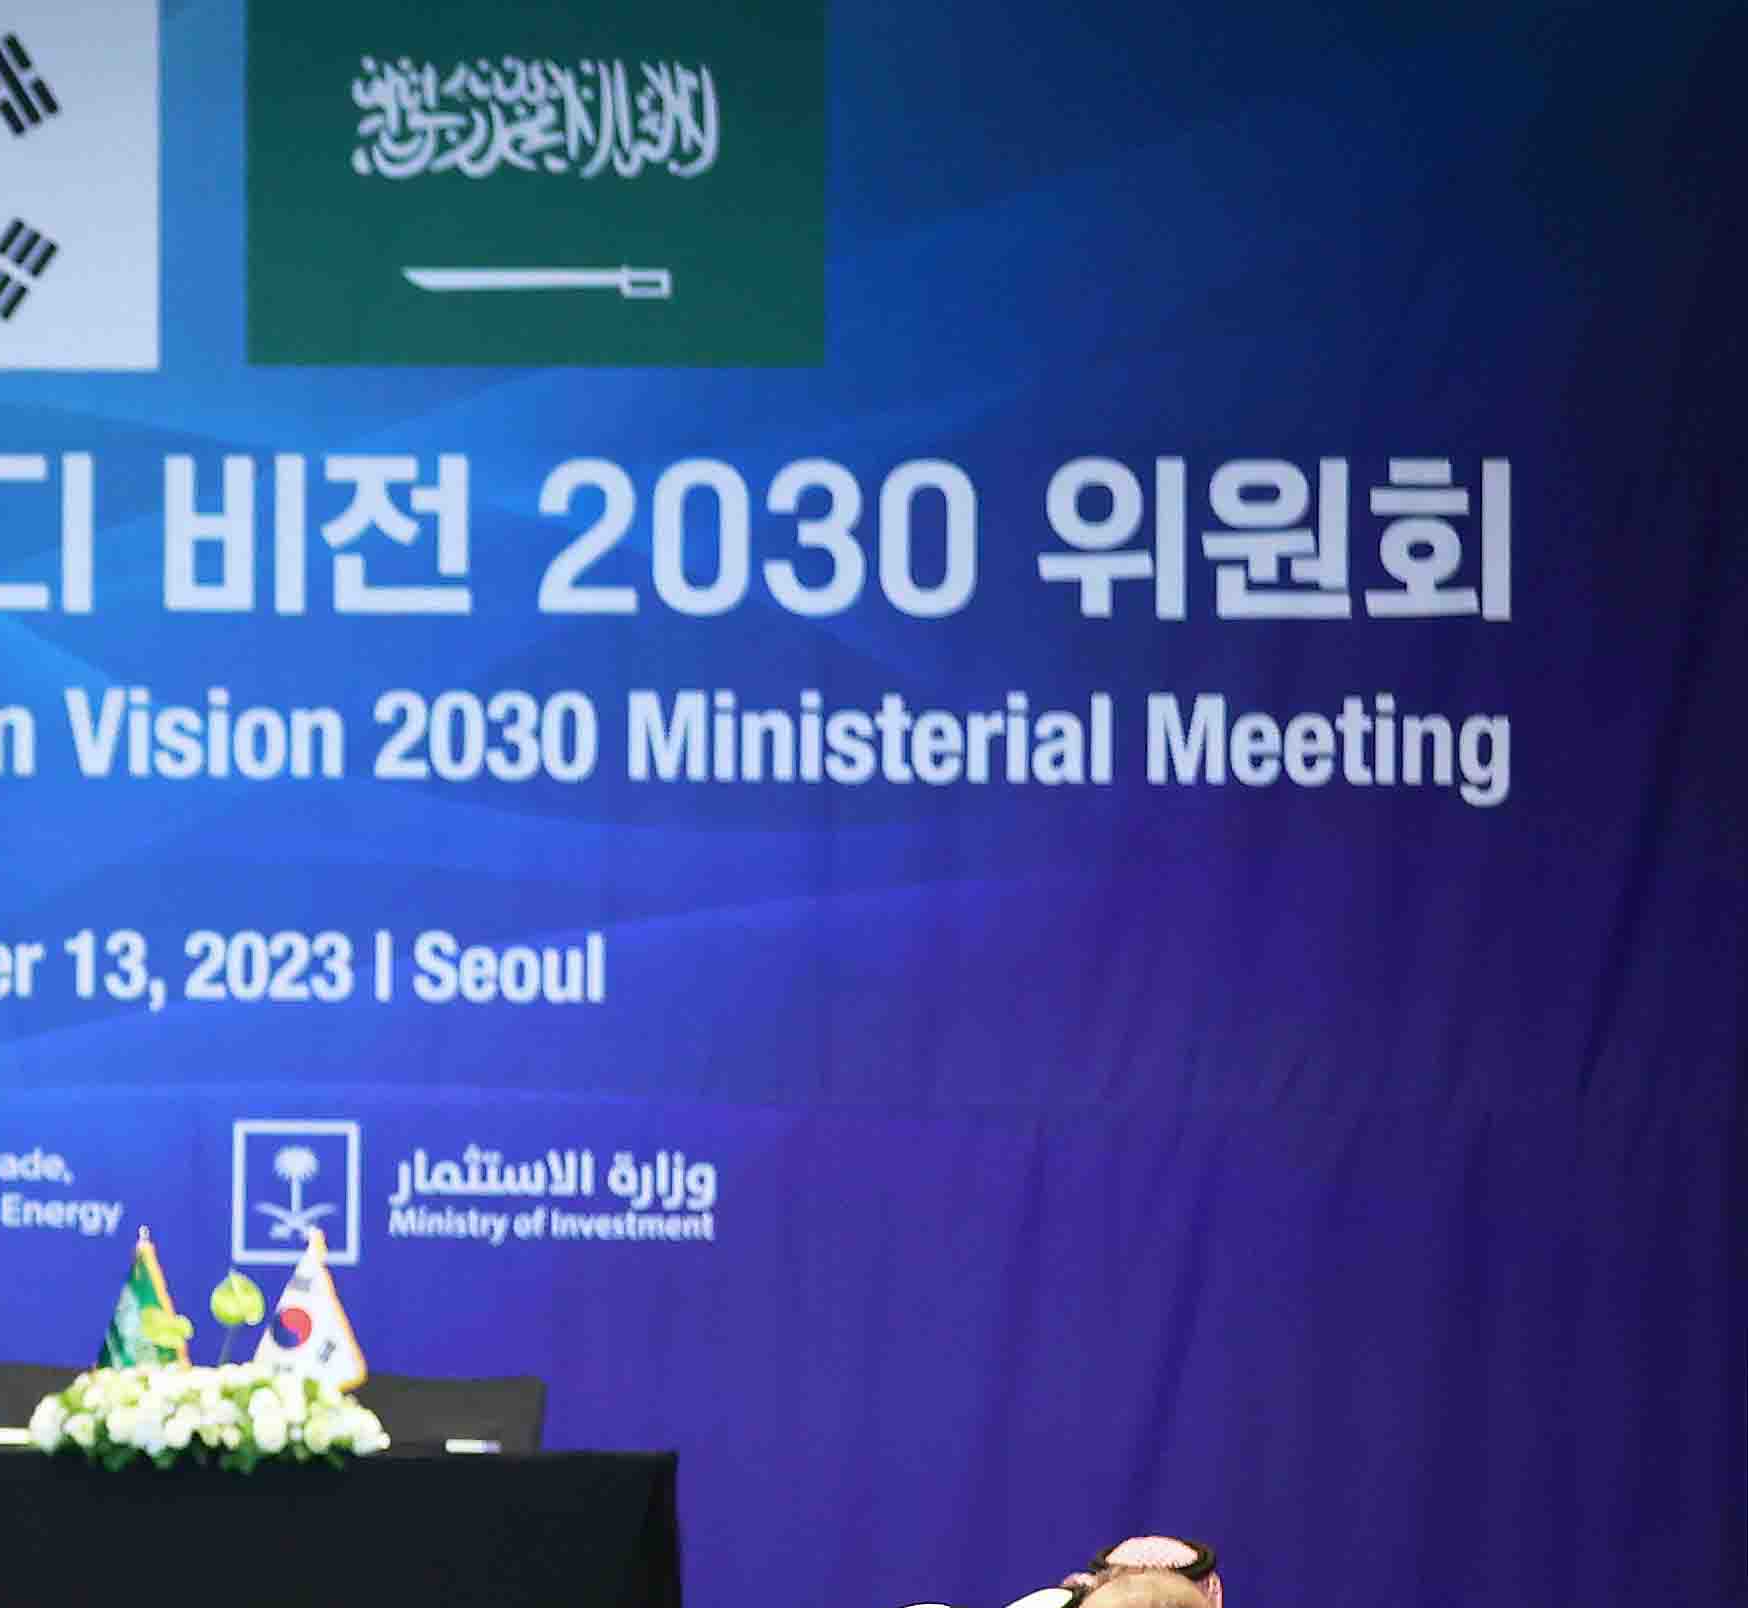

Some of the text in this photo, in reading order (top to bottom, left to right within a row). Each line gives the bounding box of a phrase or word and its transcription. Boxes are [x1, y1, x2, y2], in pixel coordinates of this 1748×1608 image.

[162, 453, 473, 615] 비전
[537, 458, 976, 616] 2030
[1037, 458, 1511, 621] 위원회
[64, 686, 344, 781] Vision
[373, 689, 598, 782] 2030
[627, 689, 1112, 786] Ministerial
[1146, 694, 1512, 807] Meeting
[64, 929, 166, 1012] 13,
[183, 930, 354, 1002] 2023
[412, 930, 605, 1004] Seoul
[0, 1192, 124, 1236] Energy
[388, 1143, 718, 1211] وزارة الاستثمار
[388, 1206, 716, 1246] Ministry of Investment
